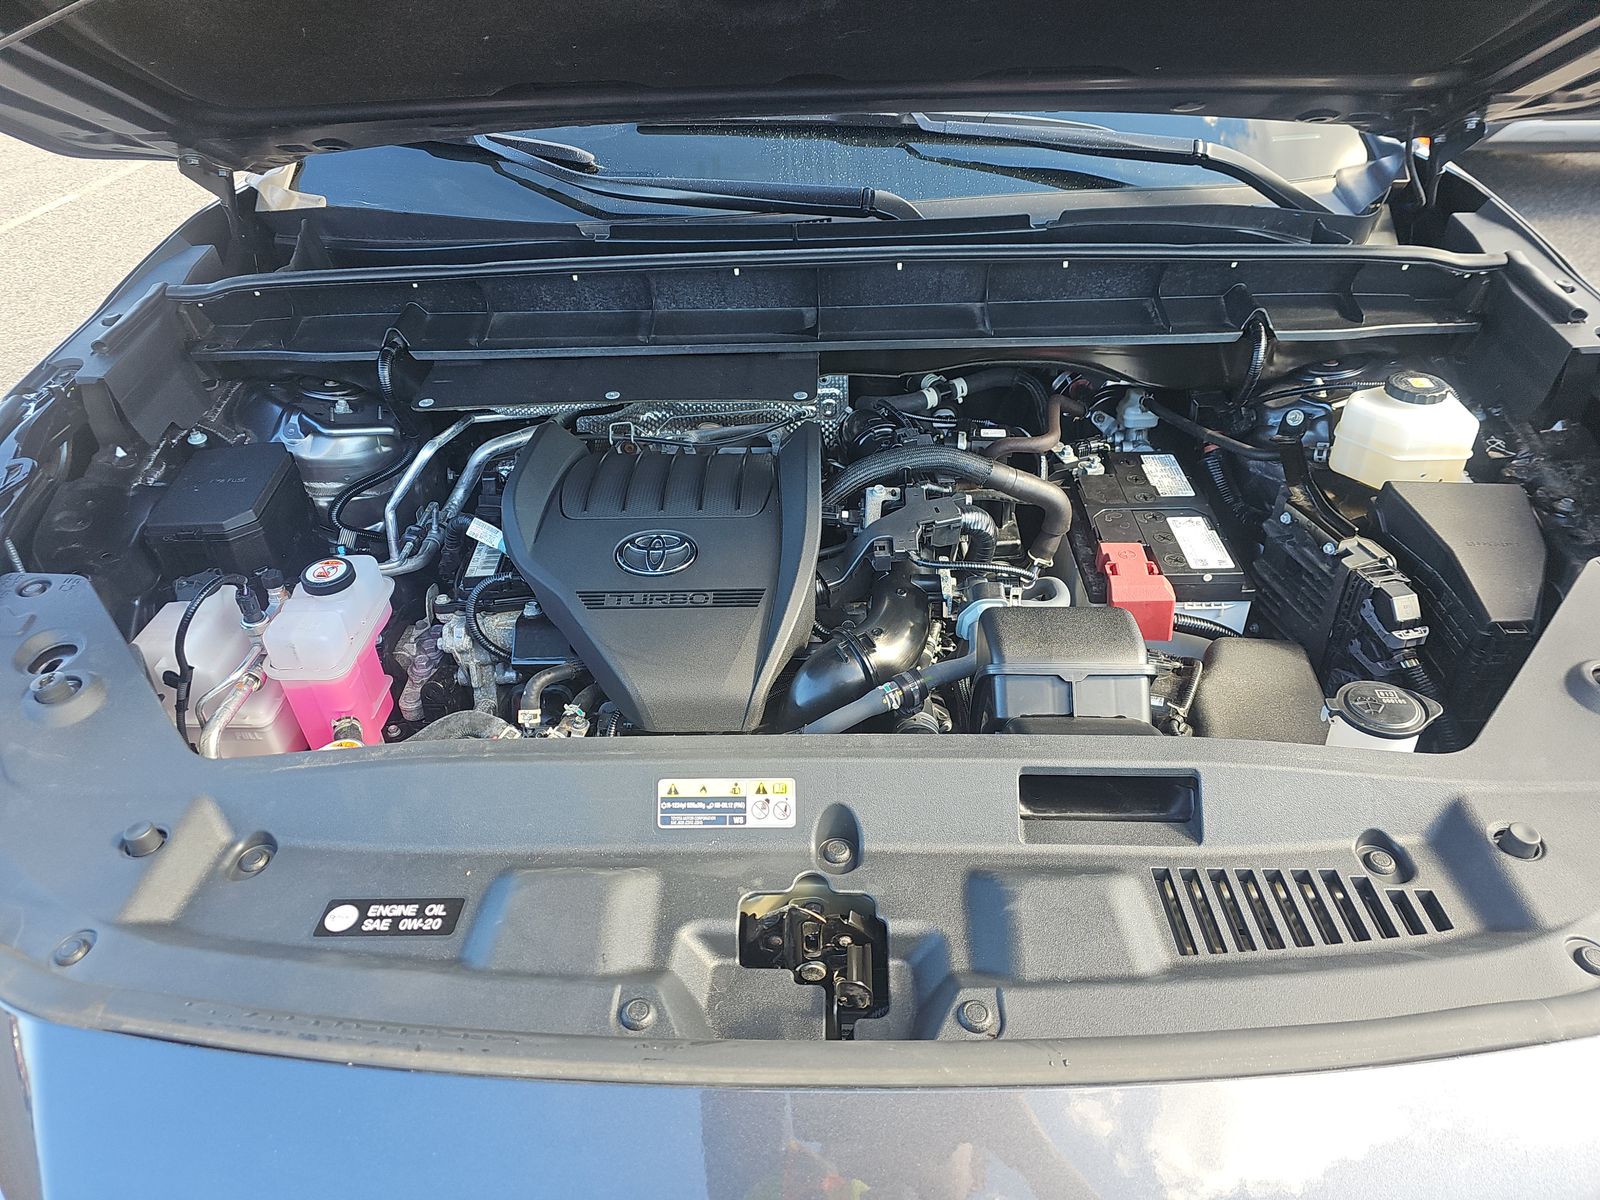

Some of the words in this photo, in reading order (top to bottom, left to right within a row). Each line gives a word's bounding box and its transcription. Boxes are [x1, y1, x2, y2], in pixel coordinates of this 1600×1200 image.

[607, 592, 710, 605] TURBO
[367, 904, 419, 917] ENGINE
[424, 904, 447, 916] OIL
[361, 918, 392, 931] SAE
[398, 918, 442, 930] 0W-20
